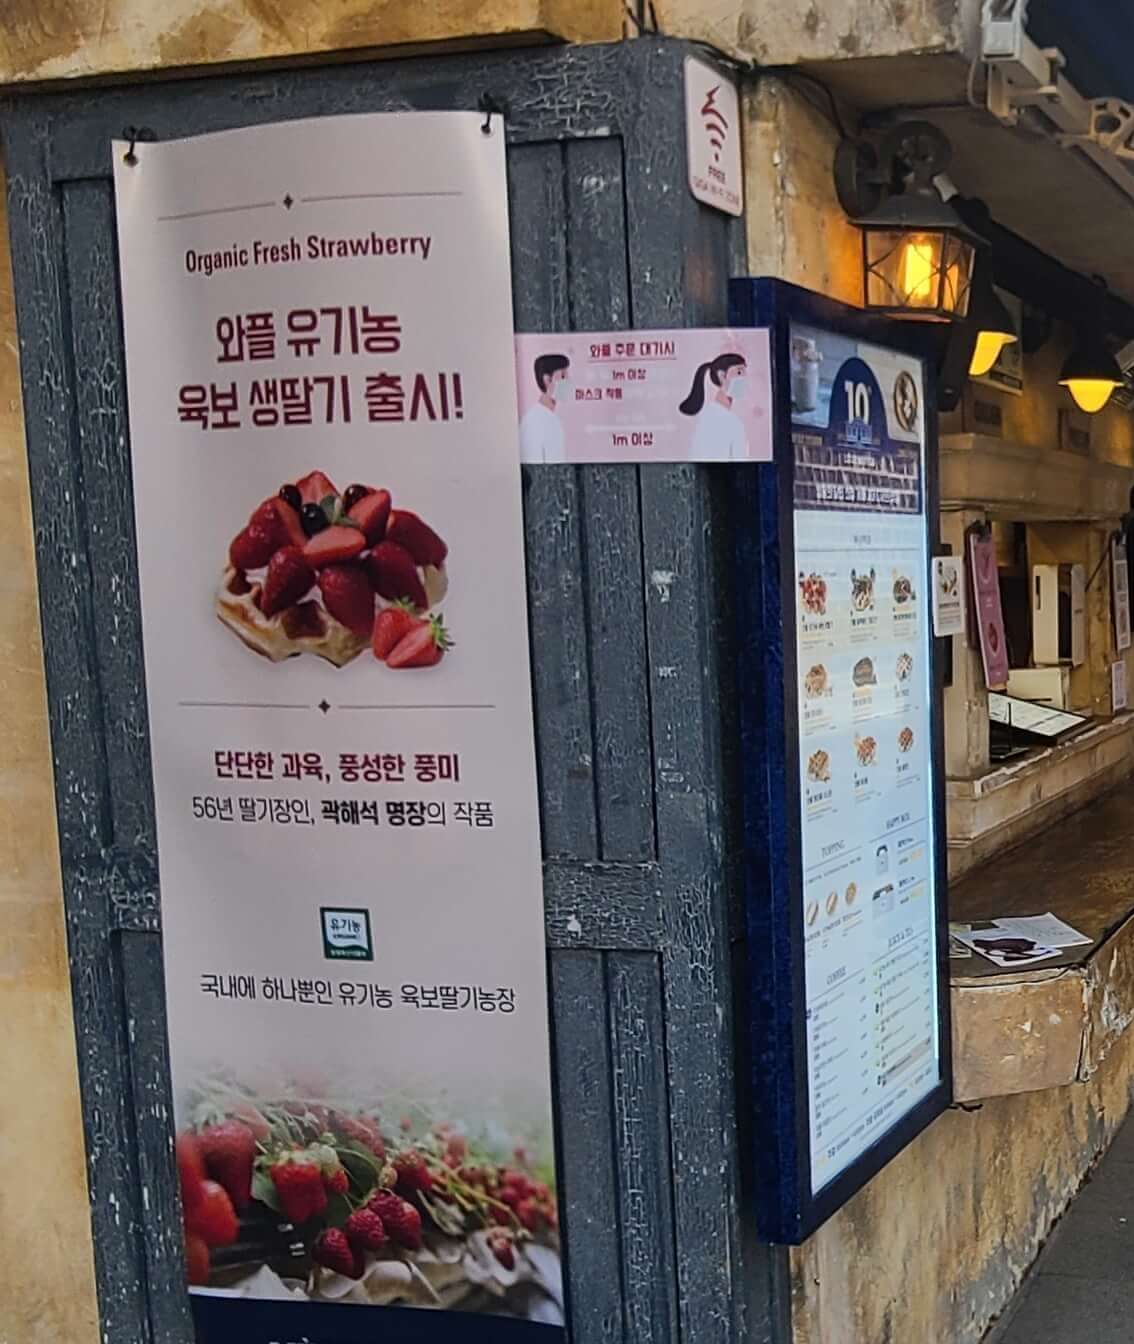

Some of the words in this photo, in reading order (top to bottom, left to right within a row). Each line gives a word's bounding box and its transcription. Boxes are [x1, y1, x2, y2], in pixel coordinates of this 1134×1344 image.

[185, 249, 249, 277] Organic
[253, 237, 301, 266] Fresh
[306, 231, 432, 261] Strawberry
[215, 311, 276, 364] 와플
[286, 305, 402, 358] 유기농
[640, 340, 675, 357] 대기시
[177, 380, 241, 431] 육보
[249, 374, 352, 428] 생딸기
[364, 371, 464, 424] 출시!
[611, 433, 628, 447] 1m
[631, 432, 654, 447] 이상
[214, 749, 274, 780] 단단한
[280, 751, 332, 784] 과육,
[338, 752, 407, 784] 풍성한
[413, 752, 461, 784] 풍미
[192, 795, 234, 821] 56년
[238, 796, 316, 826] 딸기장인,
[320, 800, 380, 826] 곽해석
[385, 800, 447, 827] 명장의
[453, 800, 495, 828] 작품
[329, 917, 362, 933] 유기농
[200, 973, 256, 1001] 국내에
[261, 976, 333, 1005] 하나뿐인
[338, 980, 393, 1009] 유기농
[400, 982, 516, 1014] 육보딸기농장
